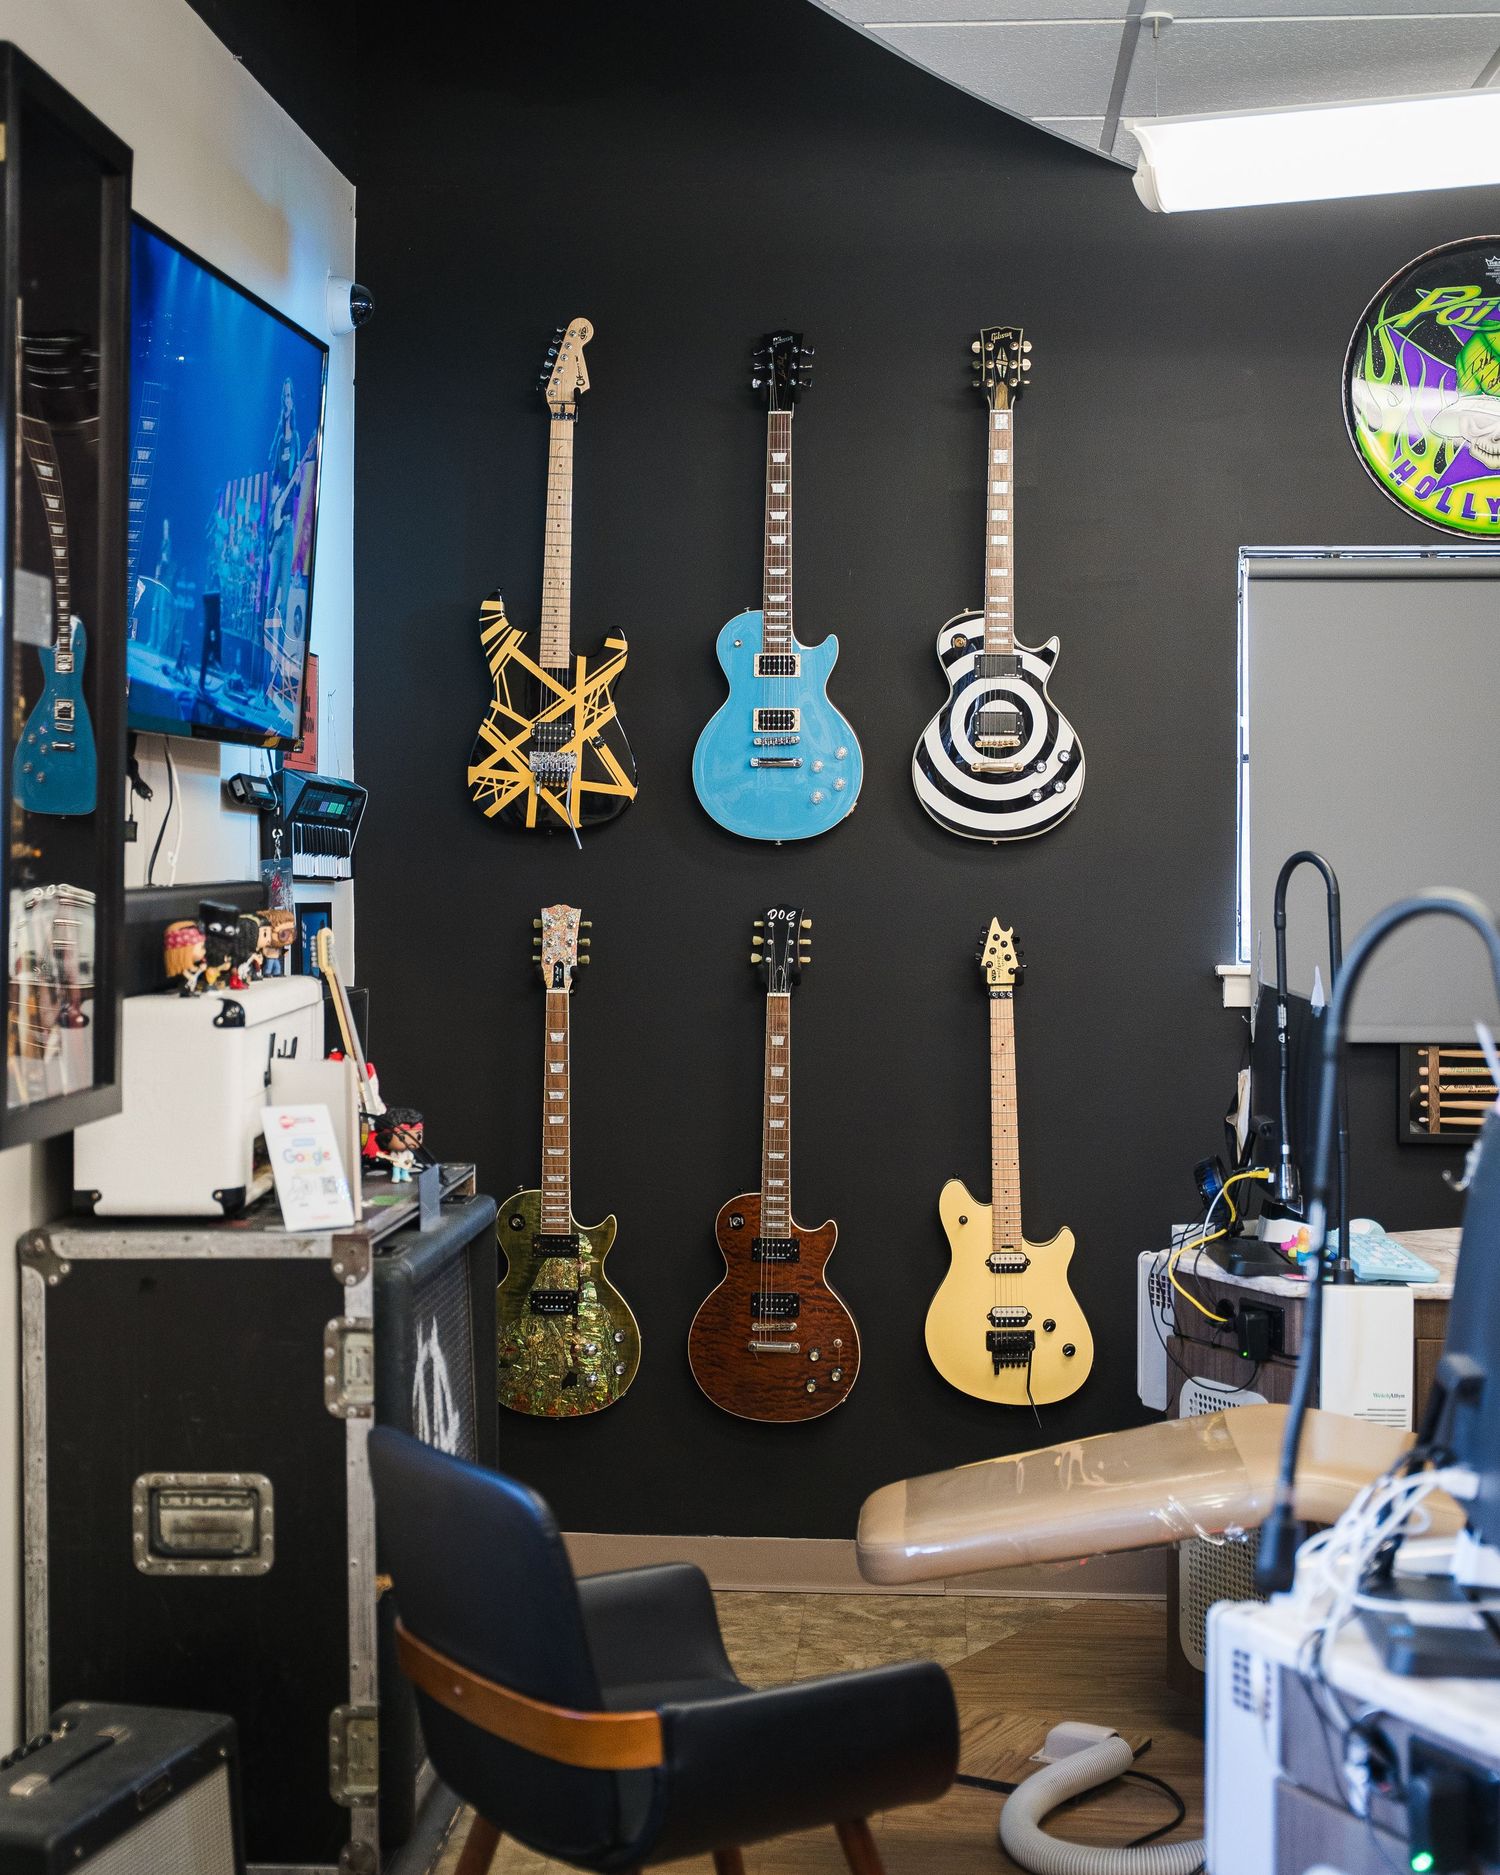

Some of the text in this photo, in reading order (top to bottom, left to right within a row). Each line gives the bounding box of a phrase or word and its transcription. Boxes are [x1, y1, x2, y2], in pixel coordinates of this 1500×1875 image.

[1374, 285, 1500, 335] Poi
[991, 331, 1013, 344] Gibson
[767, 908, 797, 921] DOC
[283, 1147, 331, 1166] Google
